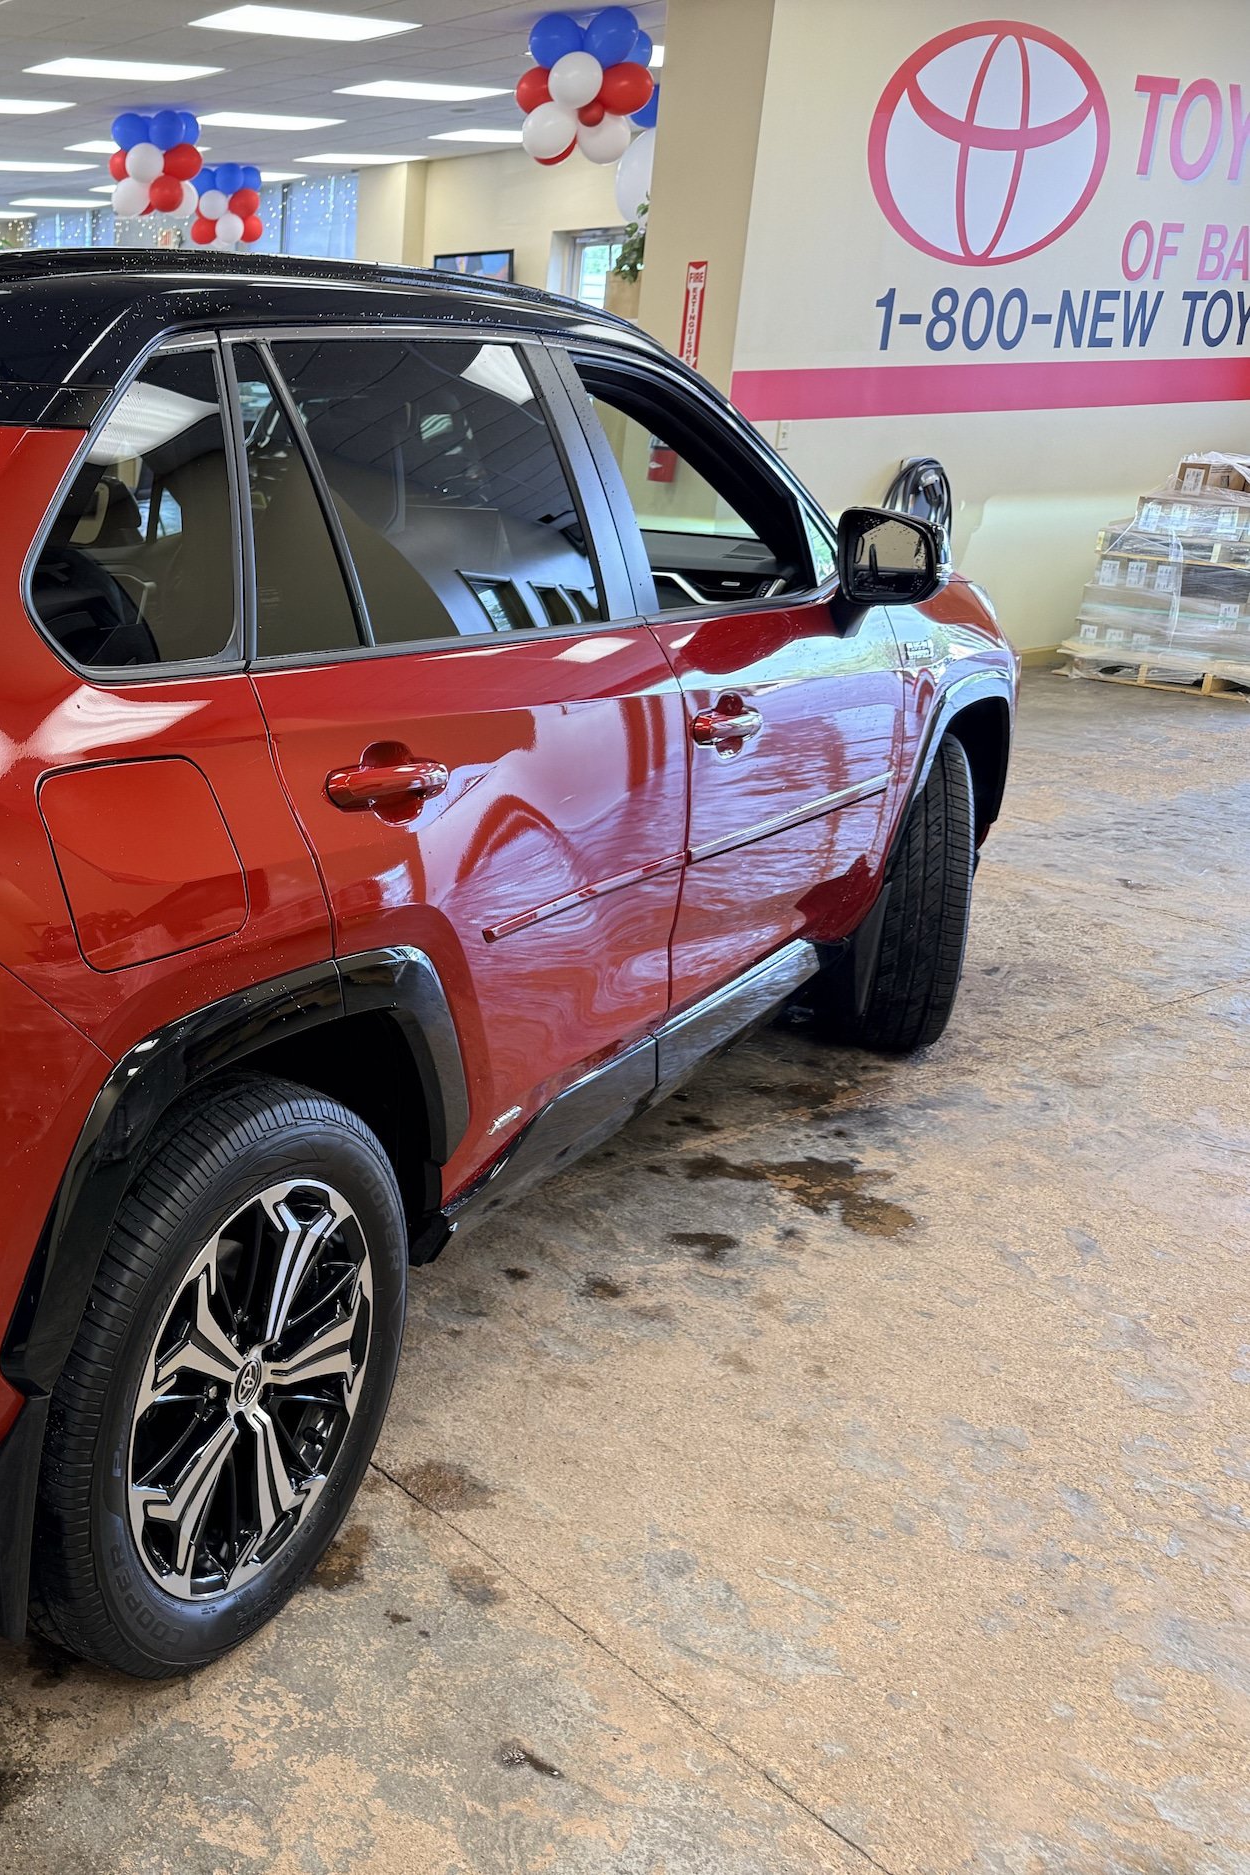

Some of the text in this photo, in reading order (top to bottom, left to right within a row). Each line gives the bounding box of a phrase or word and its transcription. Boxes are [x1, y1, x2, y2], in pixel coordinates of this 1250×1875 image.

[689, 271, 704, 283] FIRE
[1121, 220, 1250, 281] OF BA
[875, 287, 1165, 351] 1-800-NEW
[350, 1155, 402, 1273] COOPER
[109, 1540, 185, 1648] COOPER
